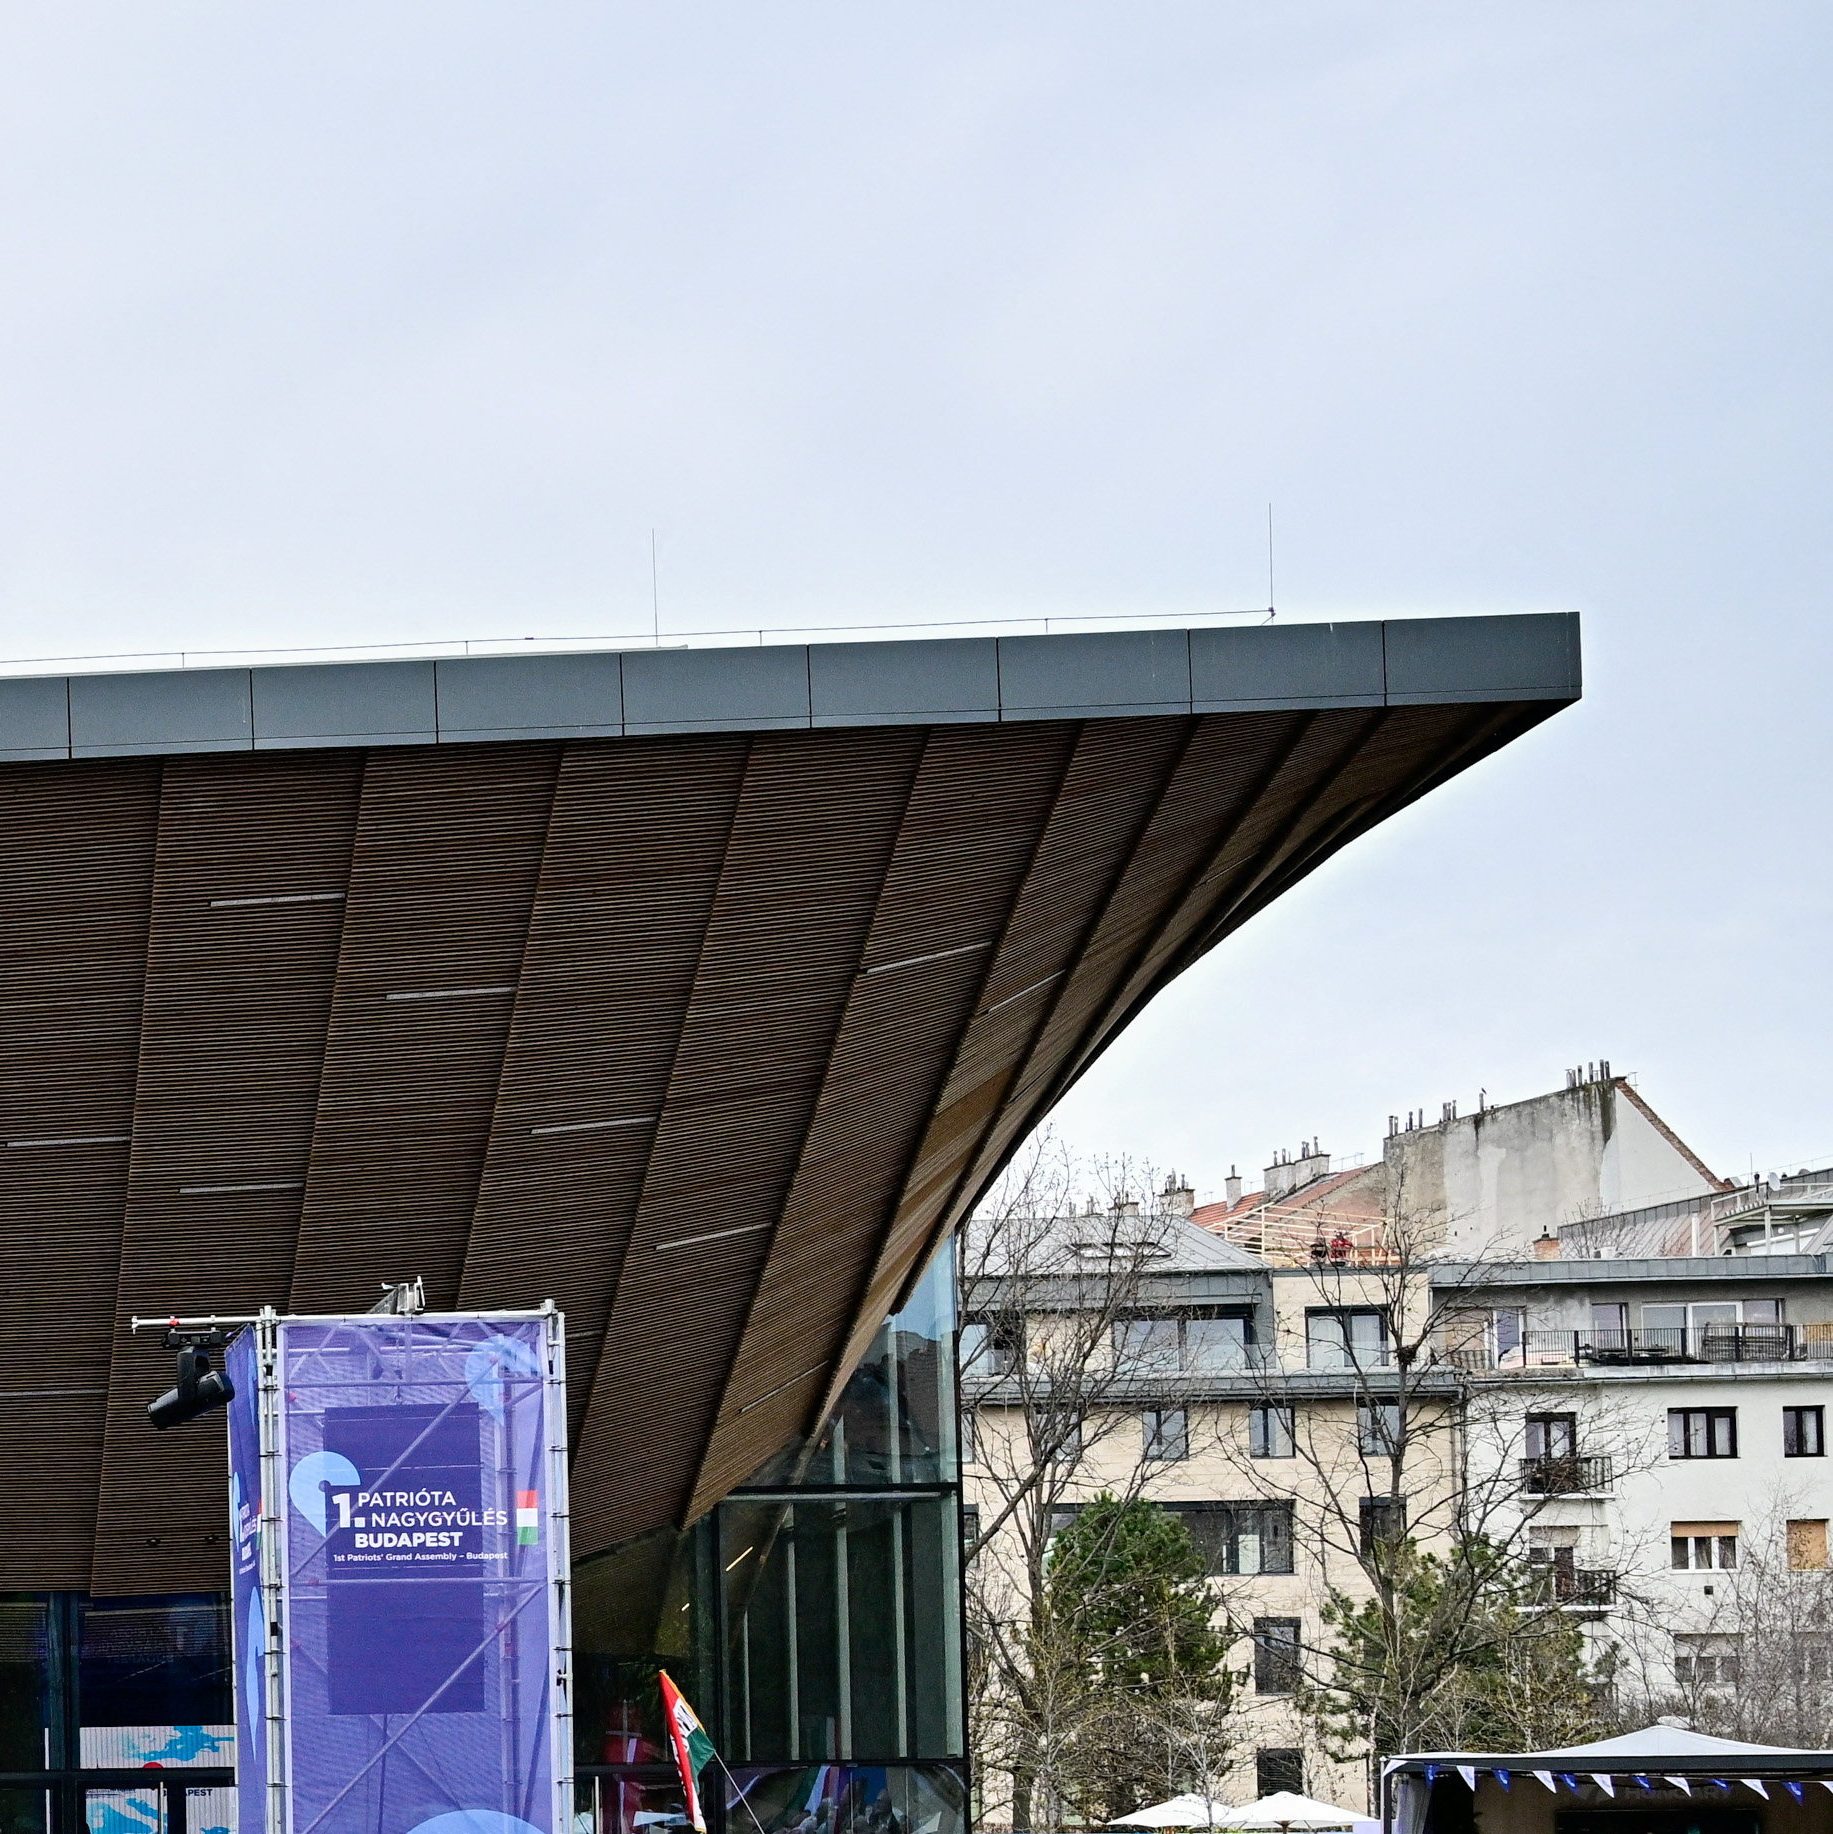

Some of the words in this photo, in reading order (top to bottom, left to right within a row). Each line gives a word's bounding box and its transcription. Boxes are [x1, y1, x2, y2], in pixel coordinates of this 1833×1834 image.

[332, 1493, 366, 1528] 1.
[358, 1488, 456, 1507] PATRIÓTA
[371, 1508, 508, 1528] NAGYGYŰLÉS
[354, 1532, 463, 1548] BUDAPEST
[334, 1554, 345, 1562] 1st
[386, 1553, 412, 1562] Grand
[414, 1552, 457, 1562] Assembly
[466, 1552, 509, 1561] Budapest
